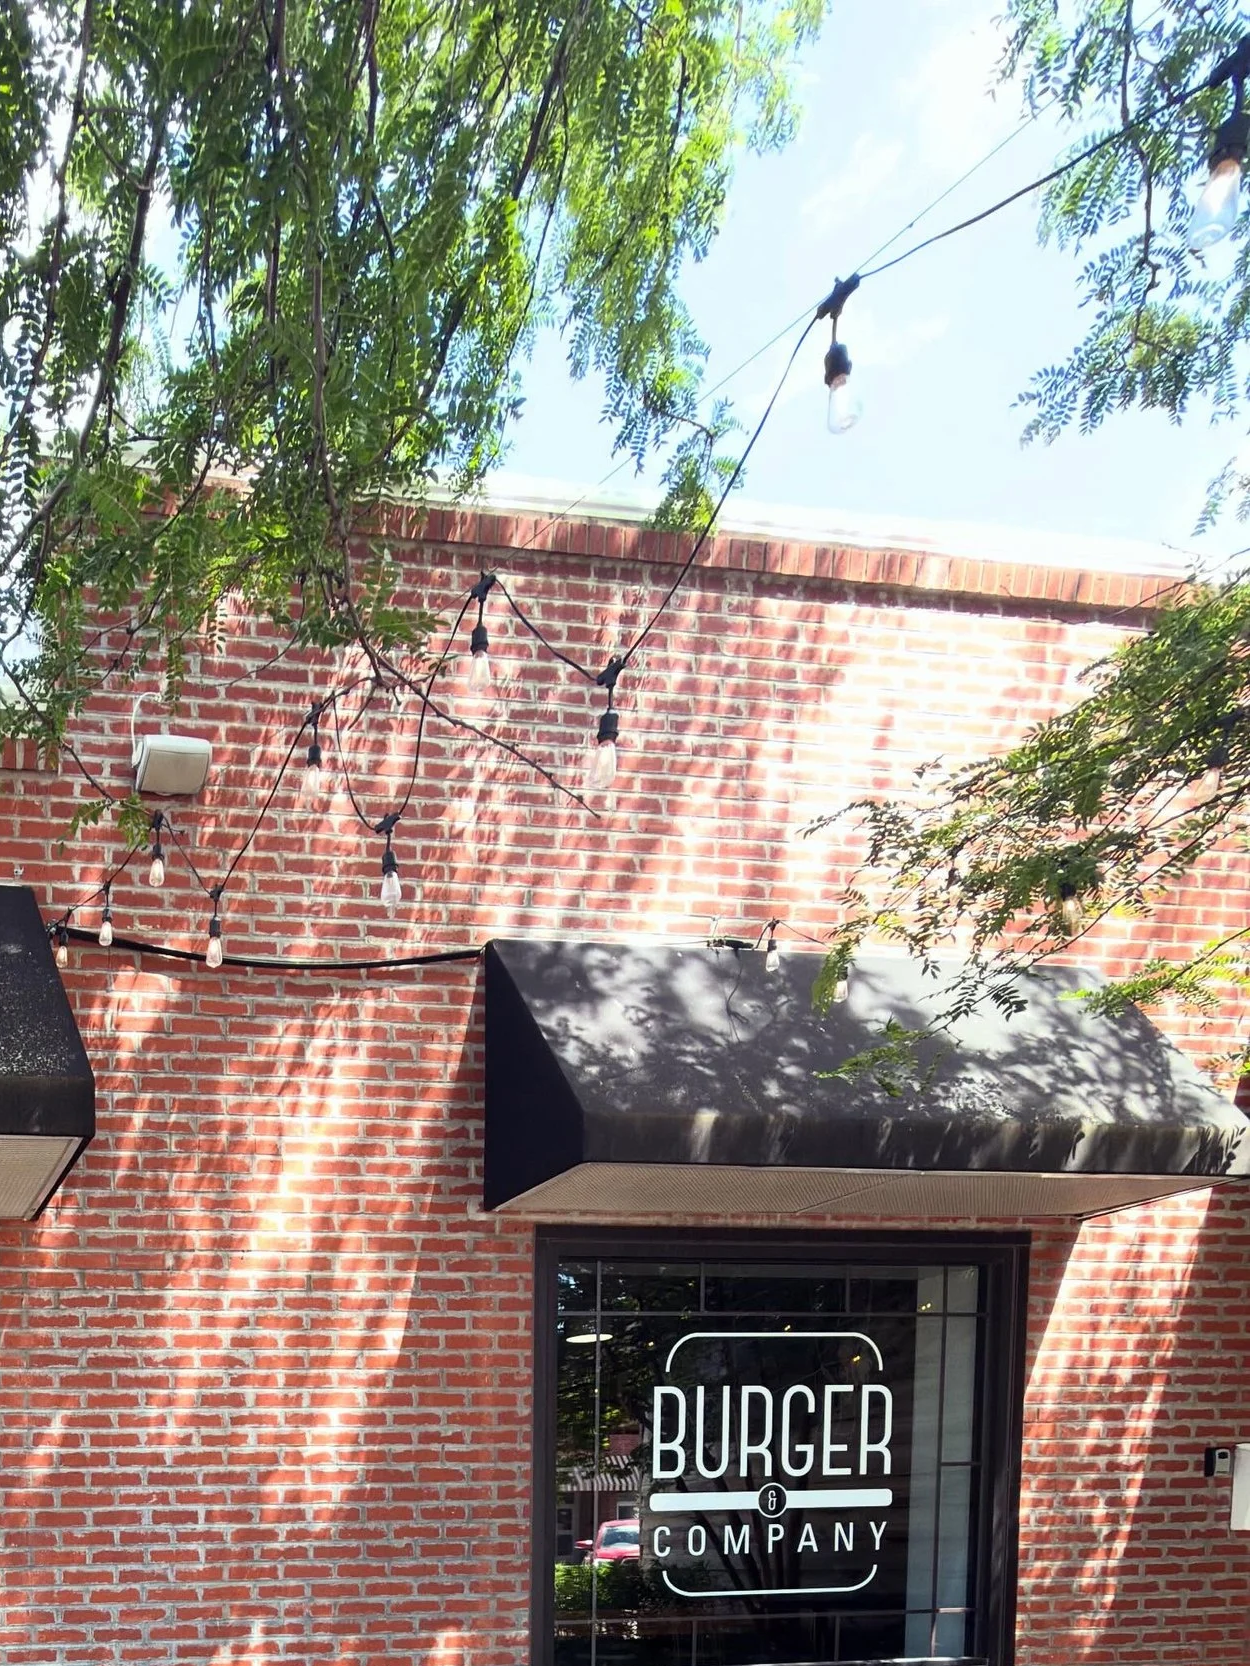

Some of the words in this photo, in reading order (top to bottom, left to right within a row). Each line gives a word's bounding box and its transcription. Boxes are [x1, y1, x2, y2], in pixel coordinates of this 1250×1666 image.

[652, 1384, 893, 1480] BURGER
[767, 1490, 778, 1511] &
[653, 1521, 888, 1558] COMPANY
